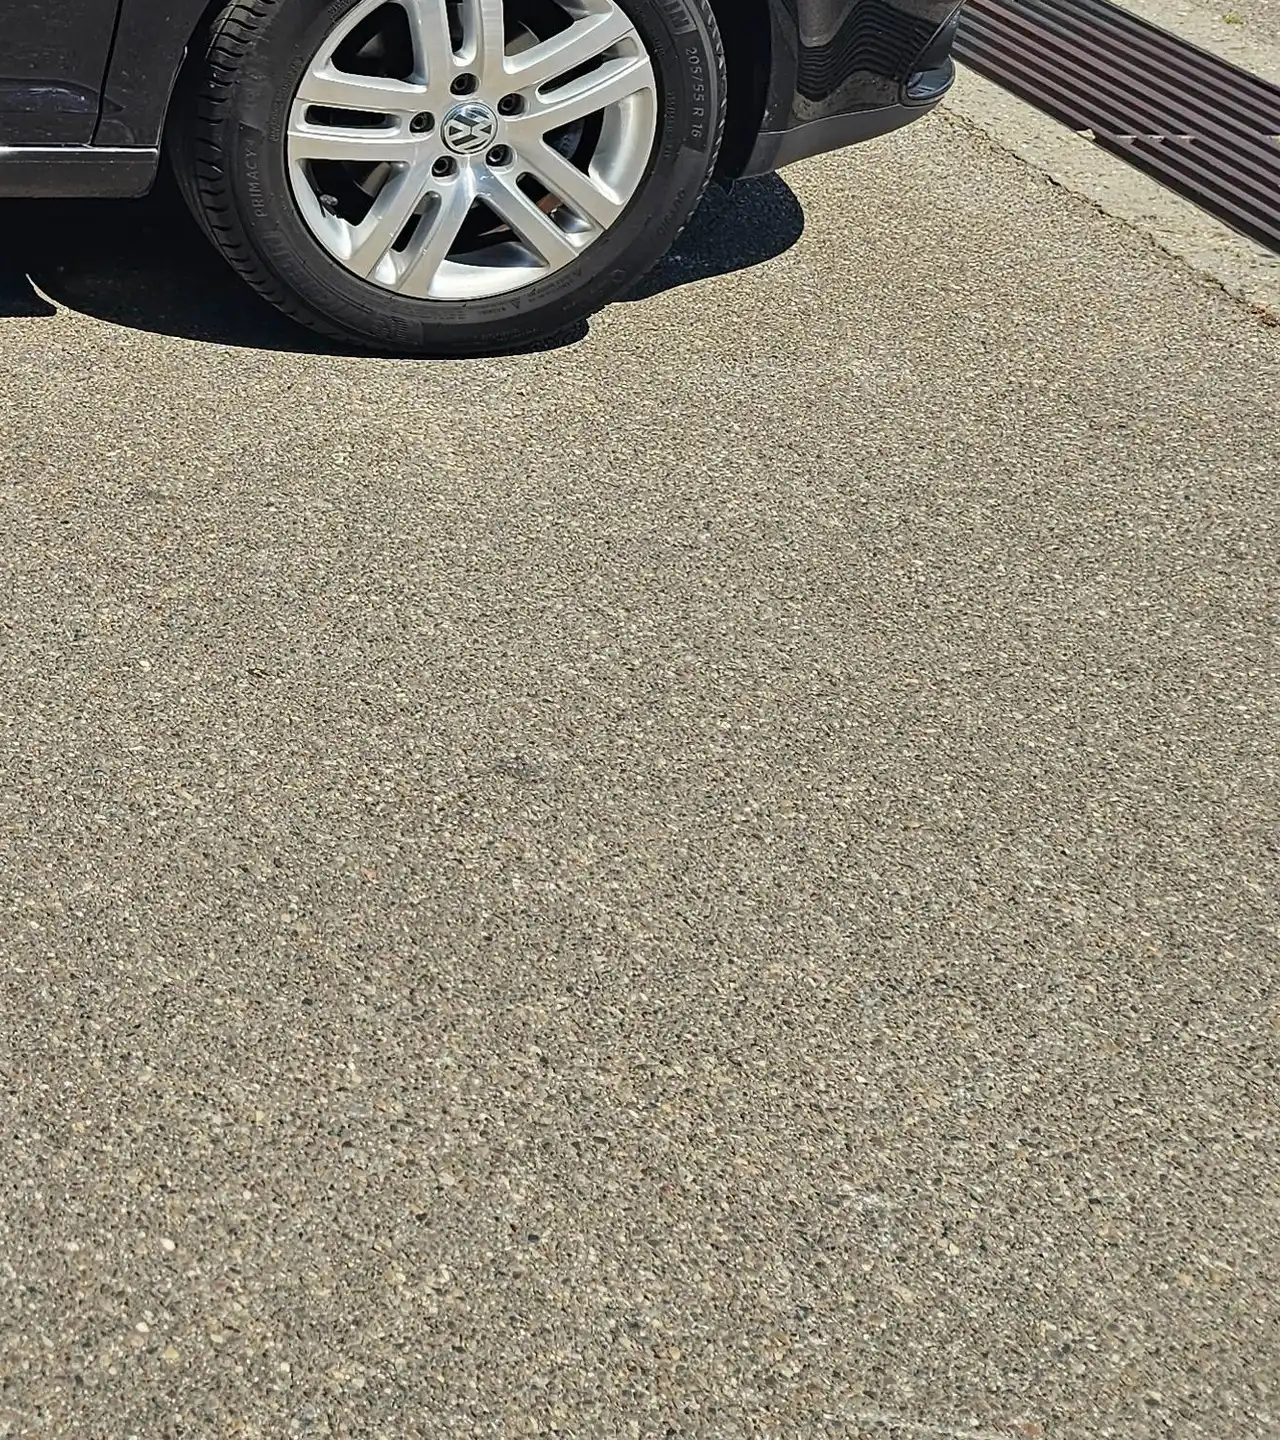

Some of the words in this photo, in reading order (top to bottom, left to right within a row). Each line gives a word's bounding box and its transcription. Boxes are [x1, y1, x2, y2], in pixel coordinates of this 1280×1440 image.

[685, 46, 705, 102] 205/55
[690, 122, 704, 138] 16
[692, 106, 705, 118] R
[245, 147, 269, 218] PRIMACY
